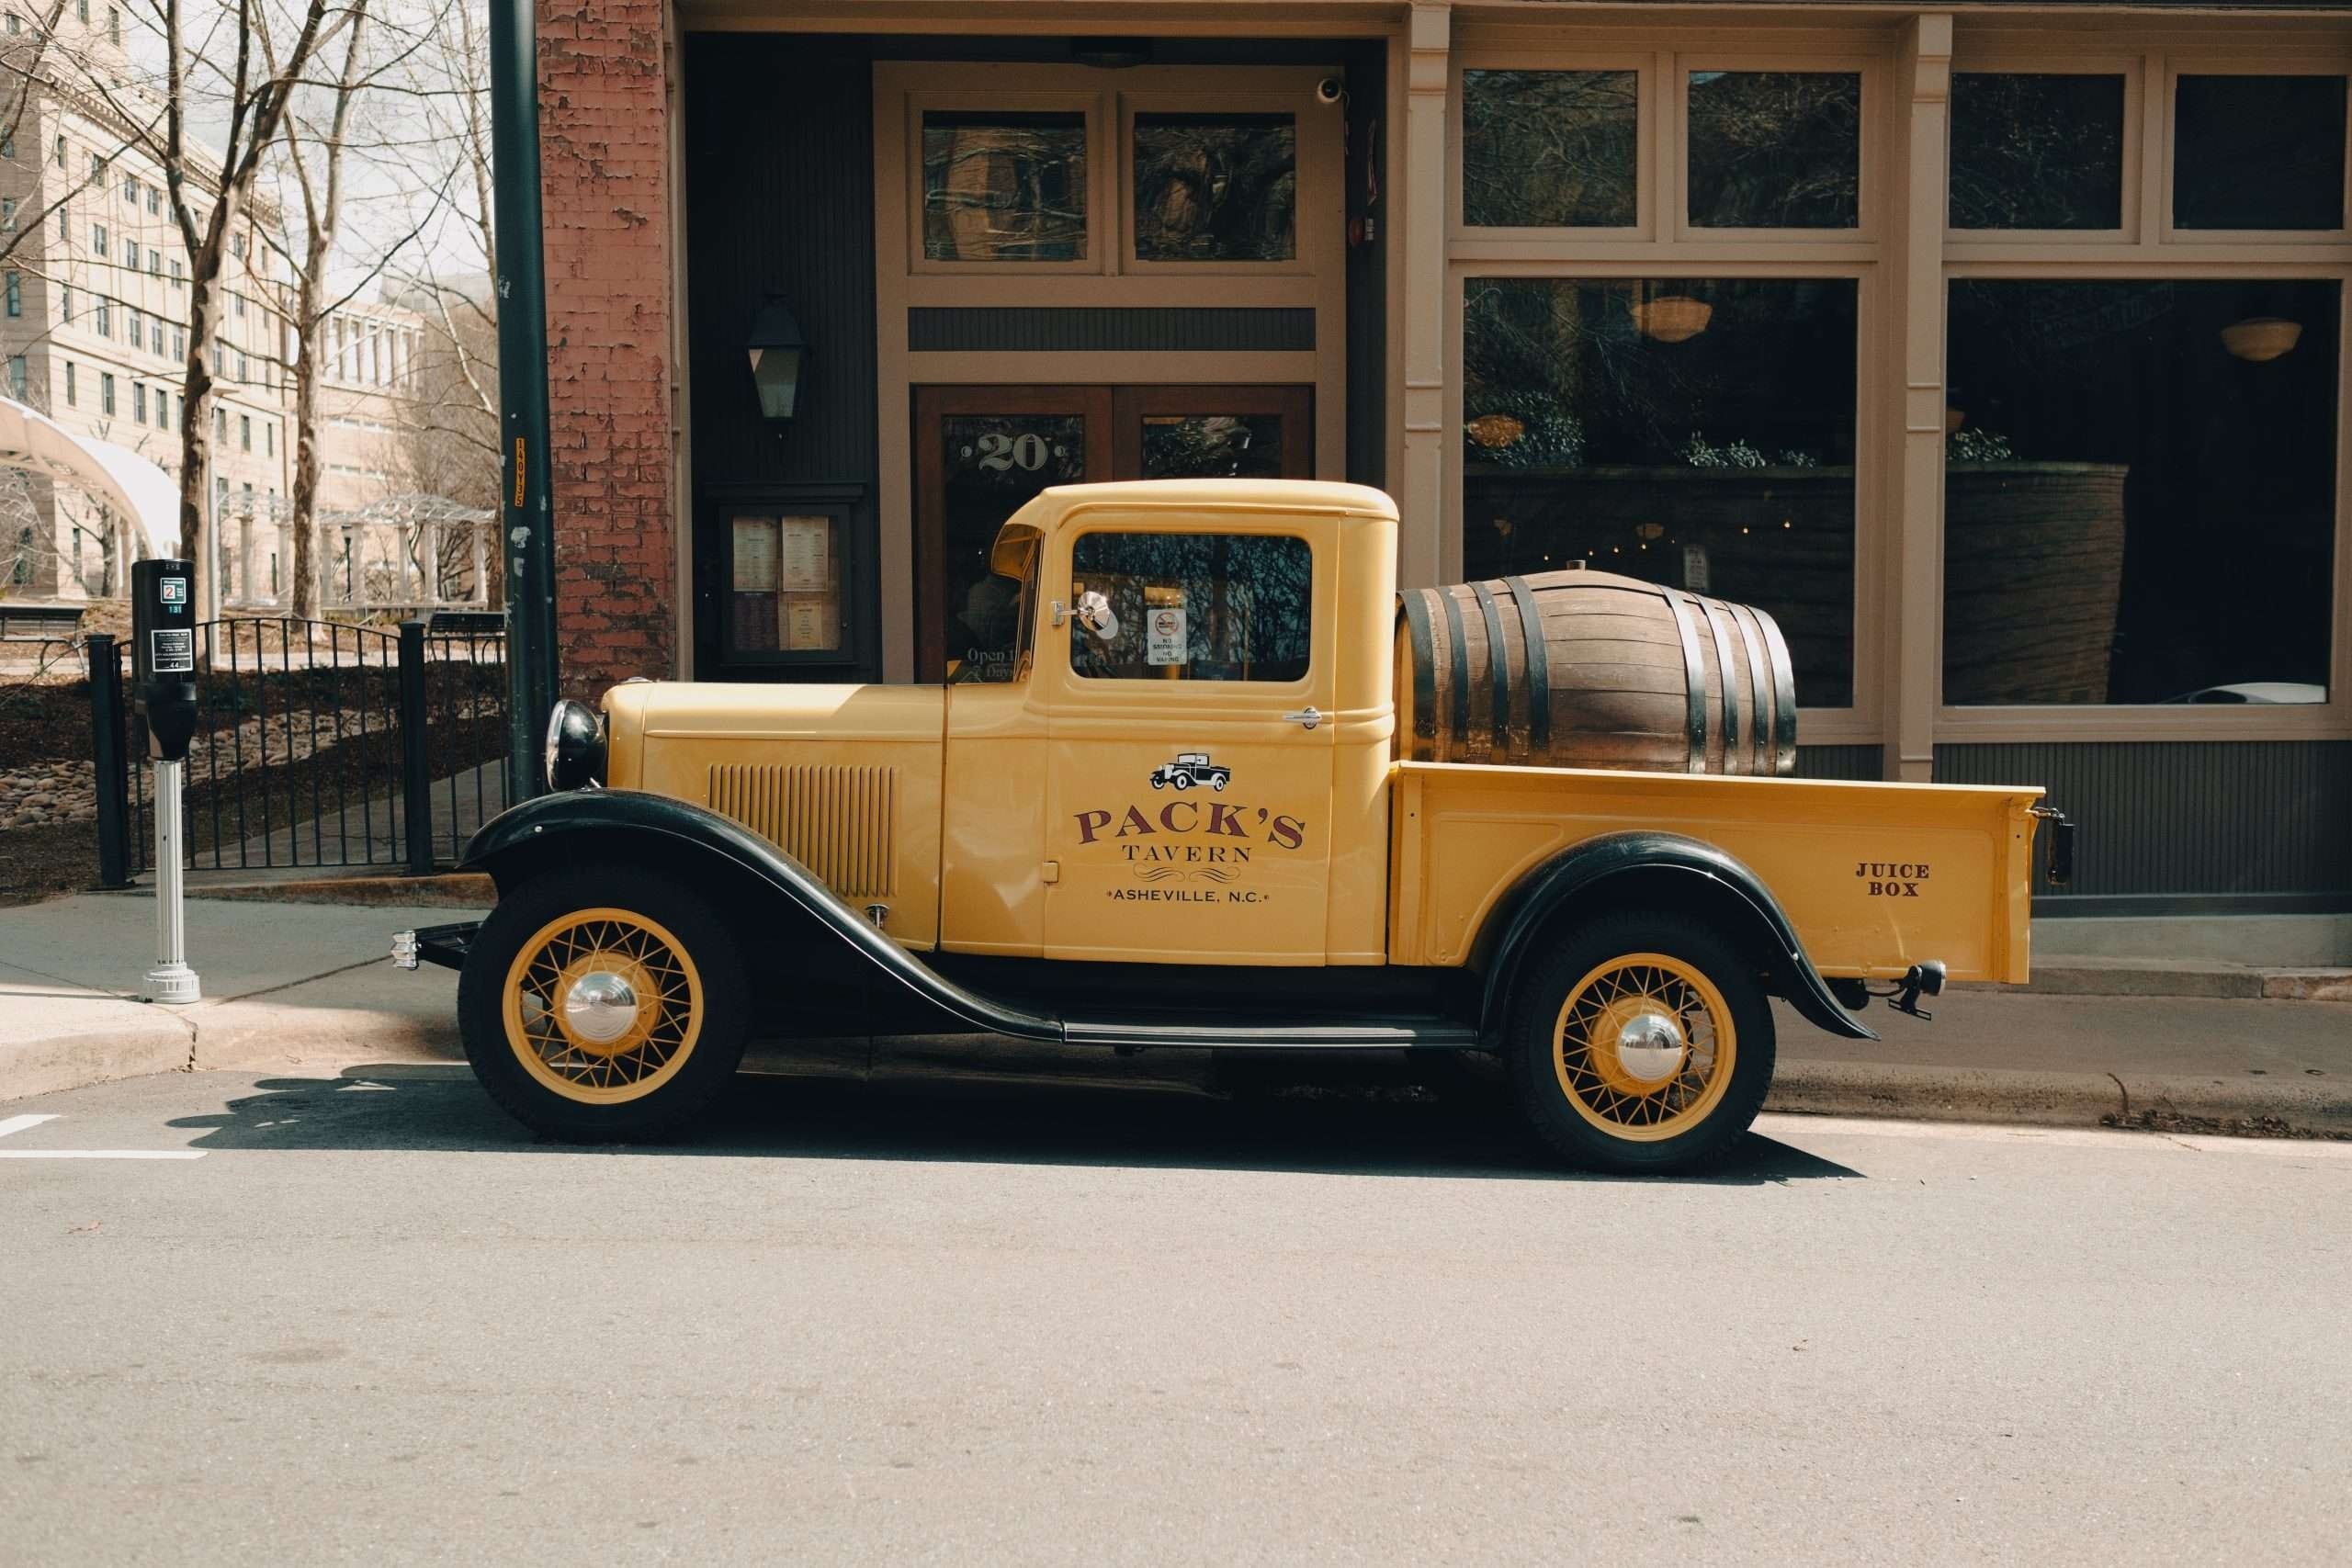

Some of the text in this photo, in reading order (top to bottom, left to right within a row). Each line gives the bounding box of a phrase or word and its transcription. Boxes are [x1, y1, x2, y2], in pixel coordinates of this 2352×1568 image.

[978, 433, 1049, 471] 20
[165, 586, 174, 597] 2
[967, 648, 1005, 665] Open
[1073, 801, 1306, 850] PACK'S
[1122, 844, 1251, 863] TAVERN
[1856, 863, 1929, 879] JUICE
[1228, 891, 1262, 903] N.C.
[1868, 881, 1918, 897] BOX
